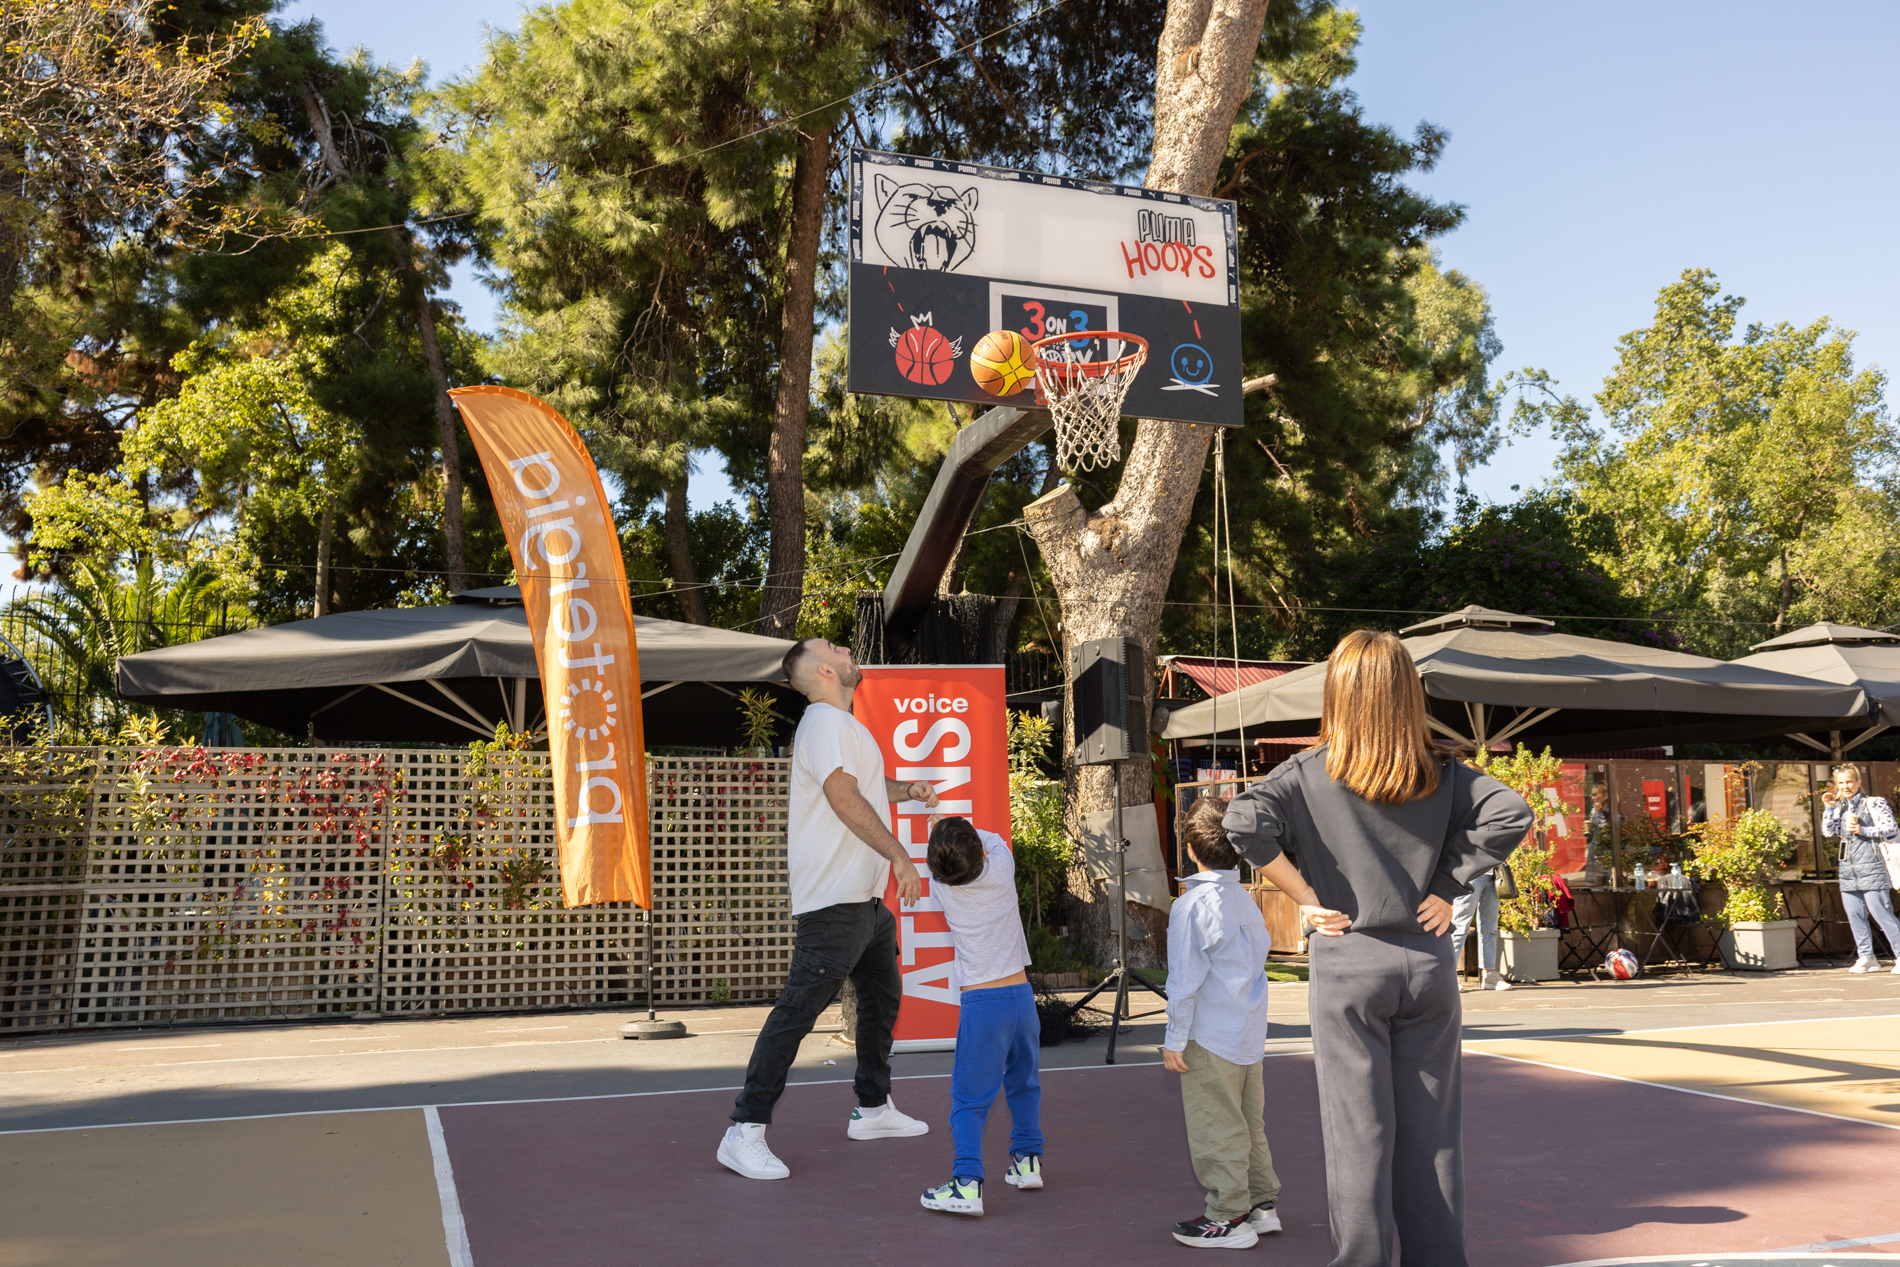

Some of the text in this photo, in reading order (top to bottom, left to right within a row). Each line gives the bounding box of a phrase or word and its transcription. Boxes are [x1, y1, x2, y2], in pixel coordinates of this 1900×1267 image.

[914, 159, 934, 168] PUMA
[958, 164, 977, 174] PUMA
[1042, 176, 1061, 185] PUMA
[1163, 193, 1181, 203] PUMA
[1137, 208, 1196, 247] PUMA
[1120, 240, 1216, 279] HOOPS
[1020, 300, 1091, 348] 3 ON 3
[893, 693, 969, 713] voice
